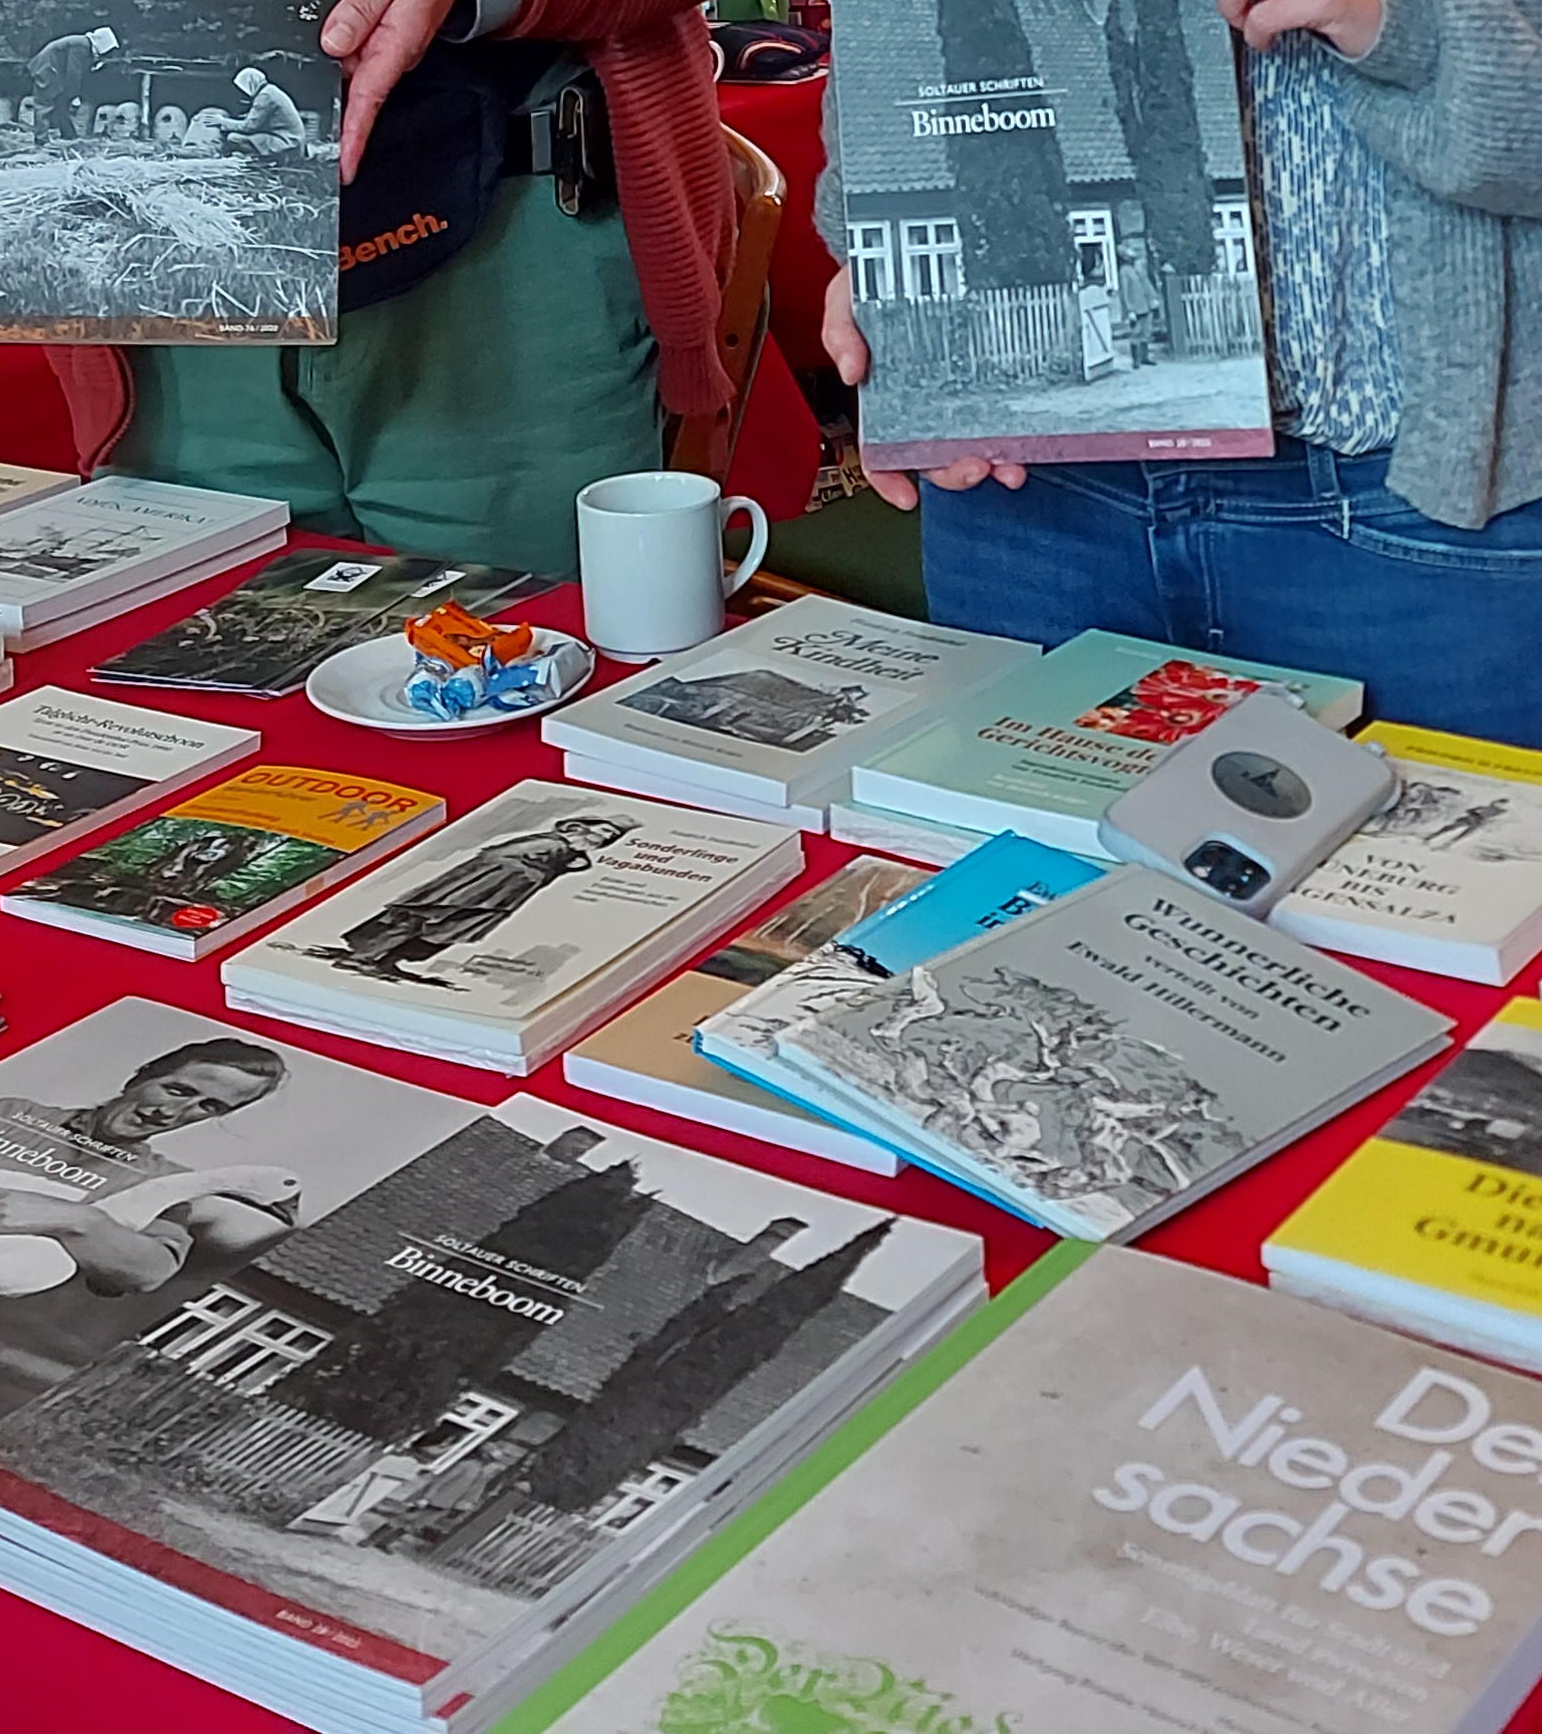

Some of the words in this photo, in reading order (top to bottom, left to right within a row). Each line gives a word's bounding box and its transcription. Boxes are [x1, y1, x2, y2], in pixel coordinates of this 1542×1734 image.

[918, 80, 977, 97] SOLTAUER
[980, 76, 1044, 93] SCHRIFTEN
[912, 103, 1056, 137] Binneboom
[772, 636, 925, 681] Kindheit
[804, 629, 940, 665] Meine
[993, 716, 1033, 733] Im
[1036, 727, 1125, 753] Hause
[241, 772, 418, 812] OUTDOOR
[595, 854, 714, 884] Vagabunden
[624, 836, 740, 865] Sonderlinge
[633, 850, 675, 865] und
[1365, 853, 1427, 874] VON
[1339, 880, 1388, 897] BIS
[1124, 912, 1342, 1033] Geschichten
[1151, 897, 1372, 1019] Wunnerliche
[1066, 940, 1145, 983] Ewald
[1141, 981, 1287, 1065] Hillermann
[1144, 954, 1216, 997] vertellt
[1218, 993, 1260, 1021] von
[11, 1111, 74, 1138] SOLTAUER
[69, 1132, 139, 1162] SCHRIFTEN
[434, 1234, 509, 1265] SOLTAUER
[505, 1259, 588, 1294] SCHRIFTEN
[384, 1246, 564, 1325] Binneboom
[1093, 1461, 1495, 1636] sachse
